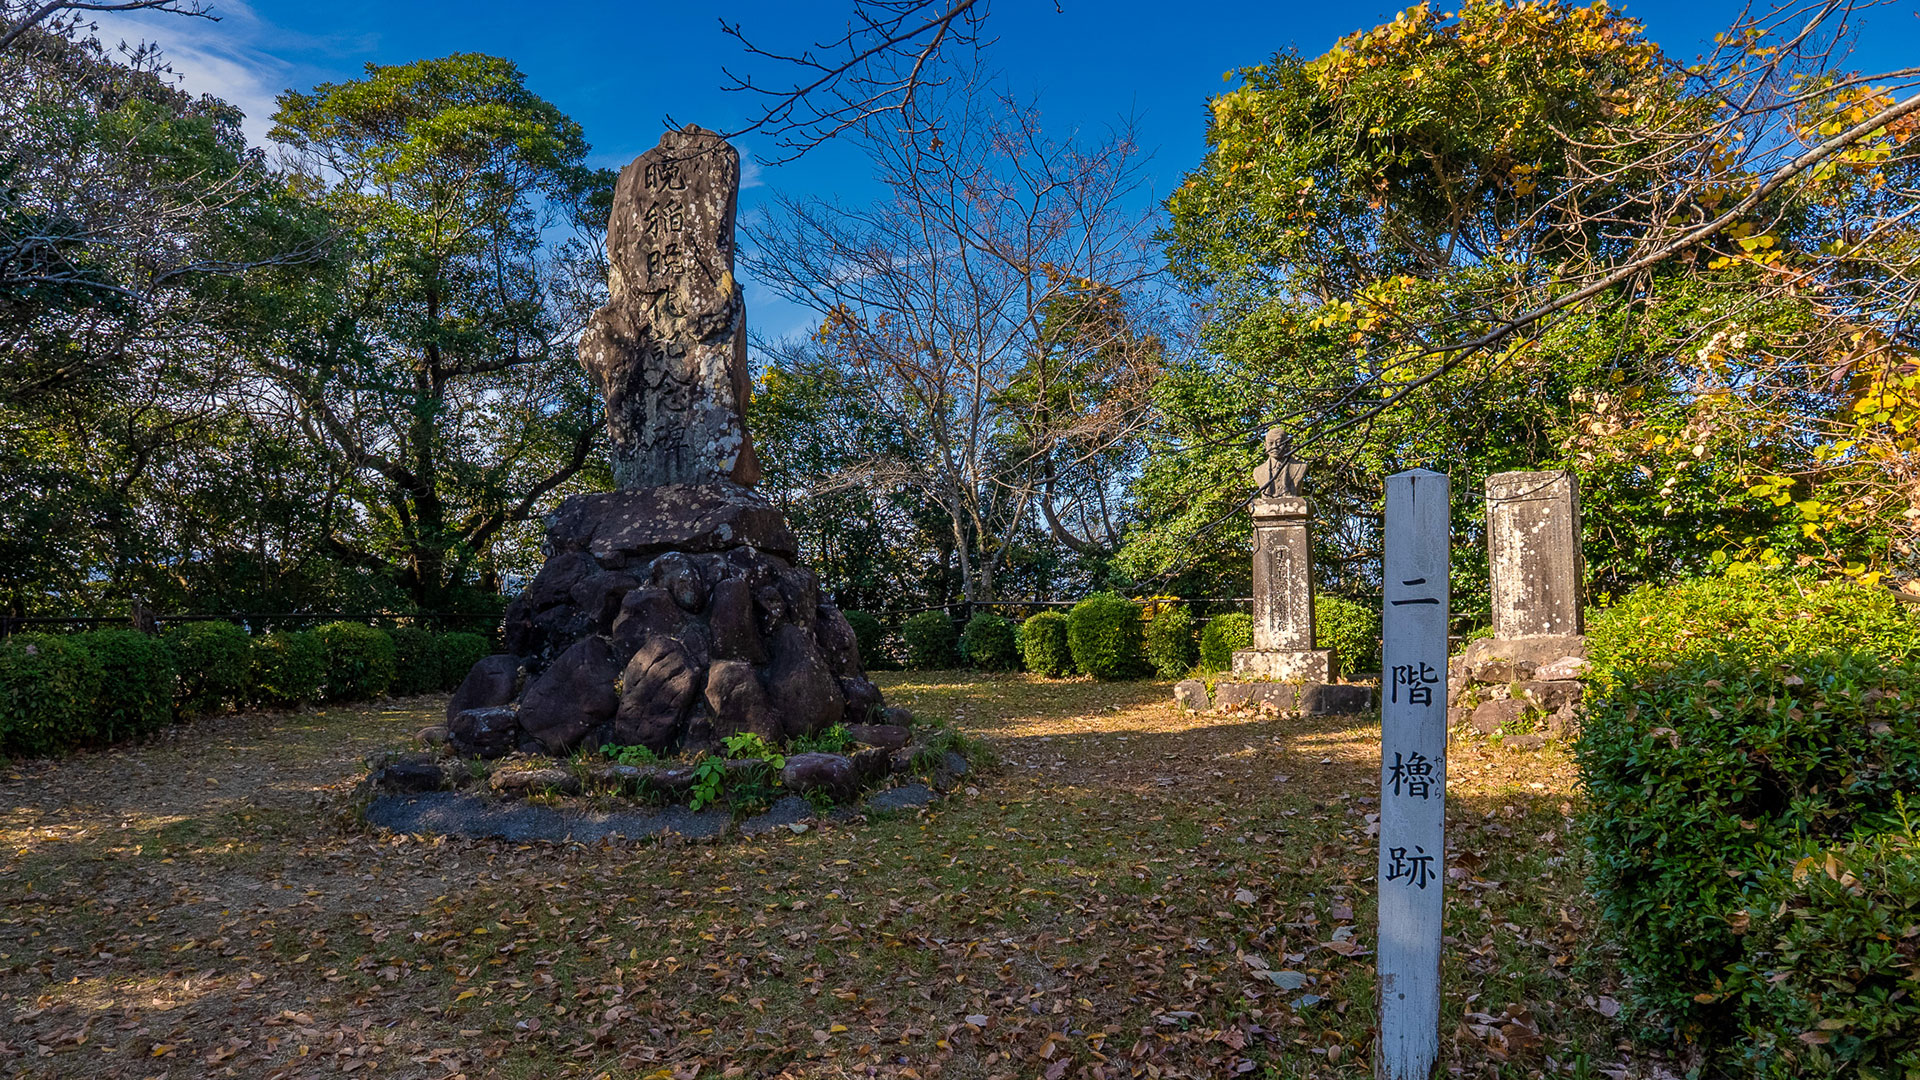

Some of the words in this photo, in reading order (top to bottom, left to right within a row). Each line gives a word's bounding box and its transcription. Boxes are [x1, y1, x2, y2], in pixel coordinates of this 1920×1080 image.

[1385, 577, 1440, 890] 二階櫓跡
[1433, 755, 1444, 800] やぐら
